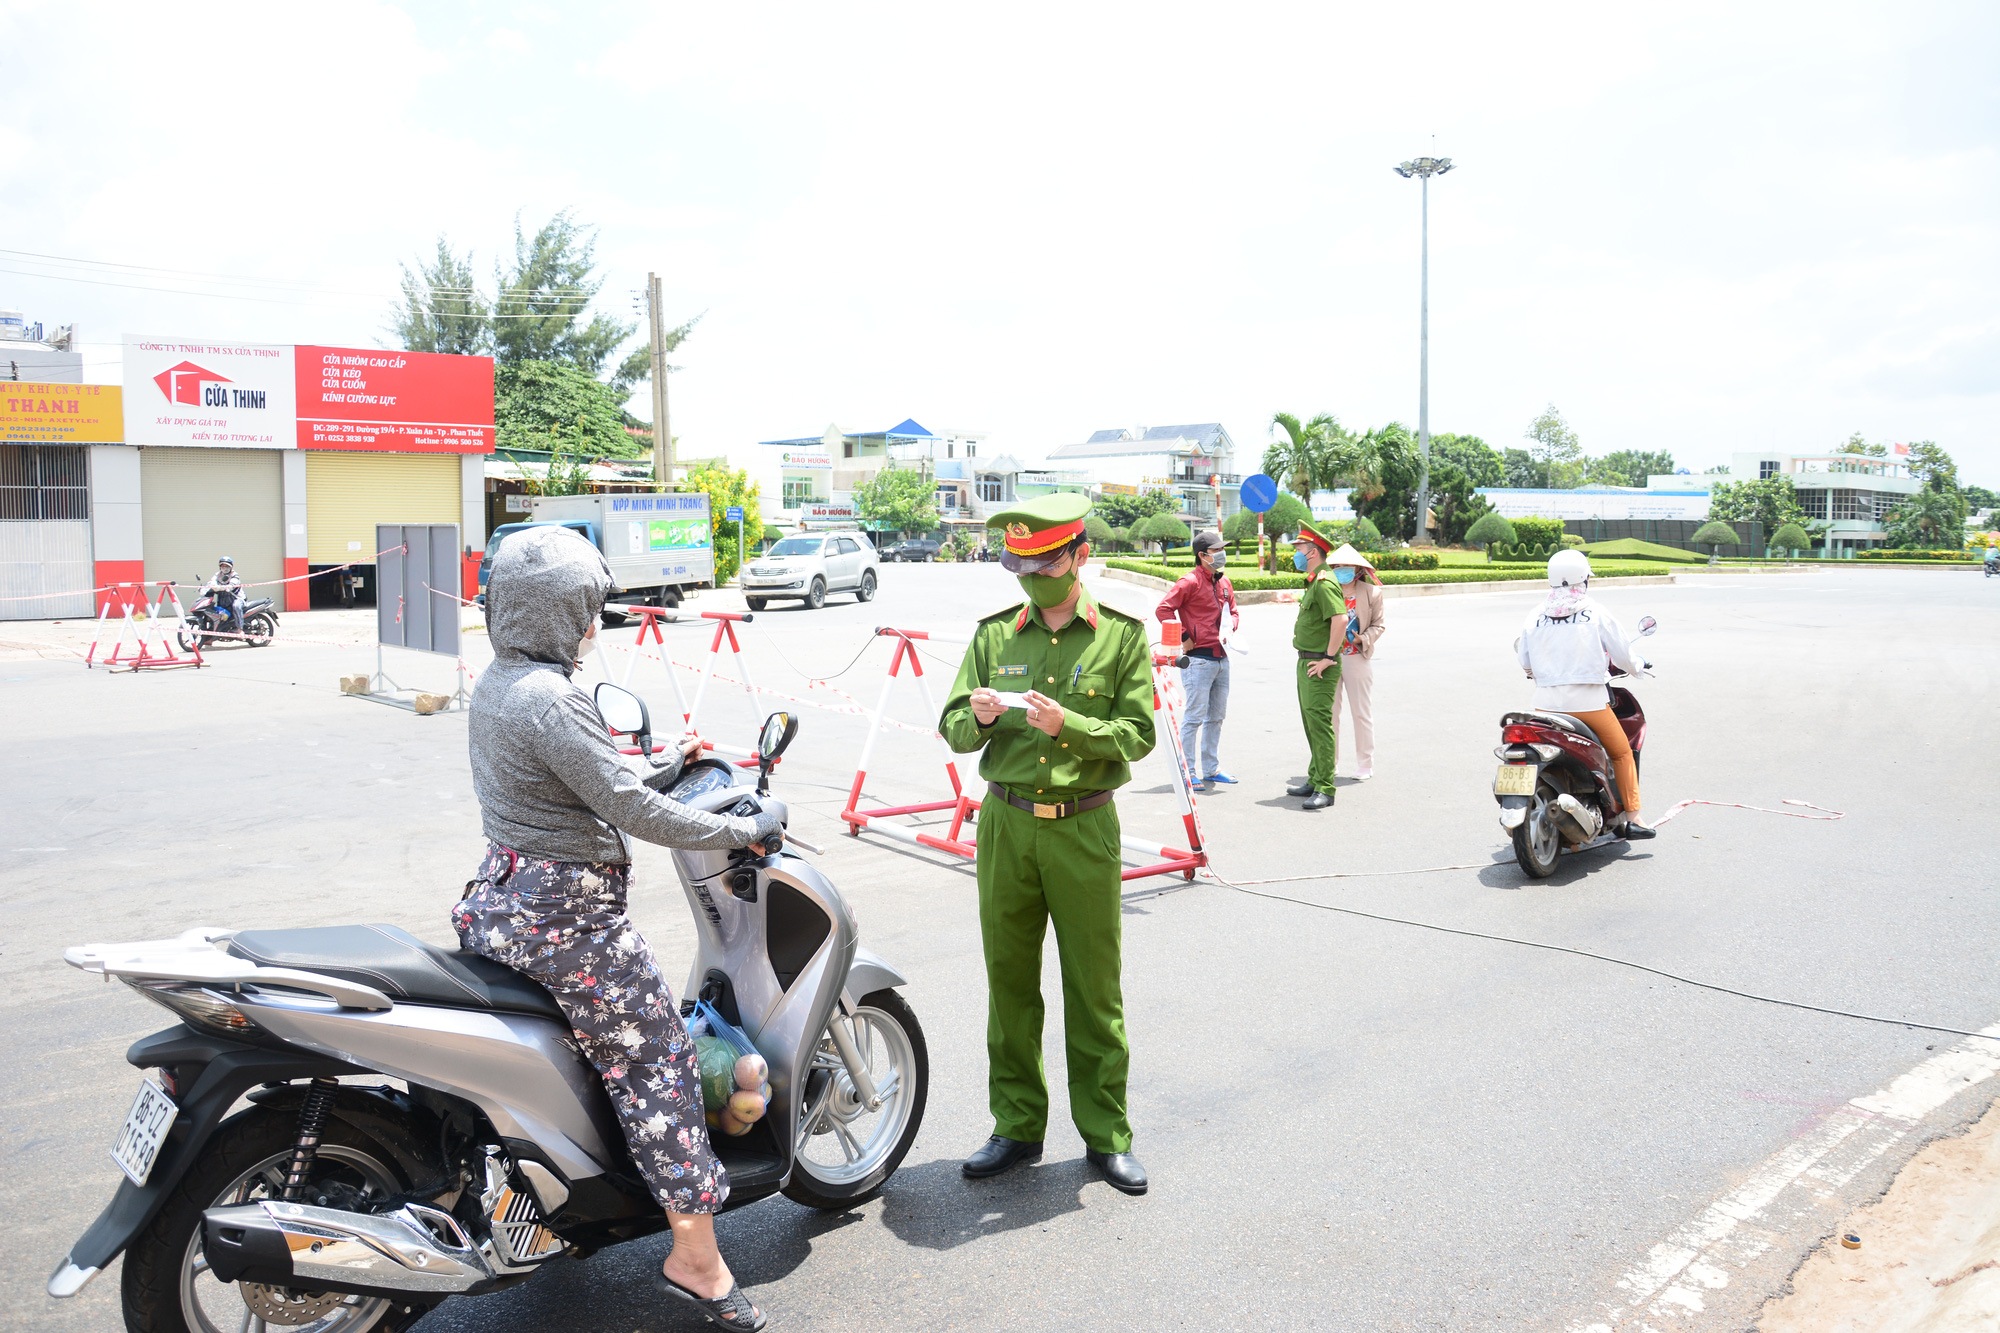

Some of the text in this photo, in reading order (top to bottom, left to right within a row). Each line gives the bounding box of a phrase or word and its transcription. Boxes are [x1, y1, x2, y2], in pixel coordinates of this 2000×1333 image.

[140, 341, 163, 351] CÔNG
[165, 344, 177, 352] TY
[179, 344, 204, 353] TNHH
[207, 346, 220, 355] TM
[222, 347, 233, 356] SX
[323, 353, 406, 368] CỬA NHÔM CAO CẤP
[322, 366, 362, 378] CỬA KÉO
[28, 384, 50, 394] KHÍ
[322, 377, 367, 389] CỬA CUỐN
[205, 383, 266, 409] CỬA THỊNH
[322, 391, 397, 406] KÍNH CƯỜNG LỰC
[7, 398, 79, 413] THANH
[156, 416, 172, 425] XÂY
[174, 418, 197, 426] DỰNG
[198, 418, 212, 427] GIÁ
[612, 497, 703, 511] NPP MINH MINH TRANG
